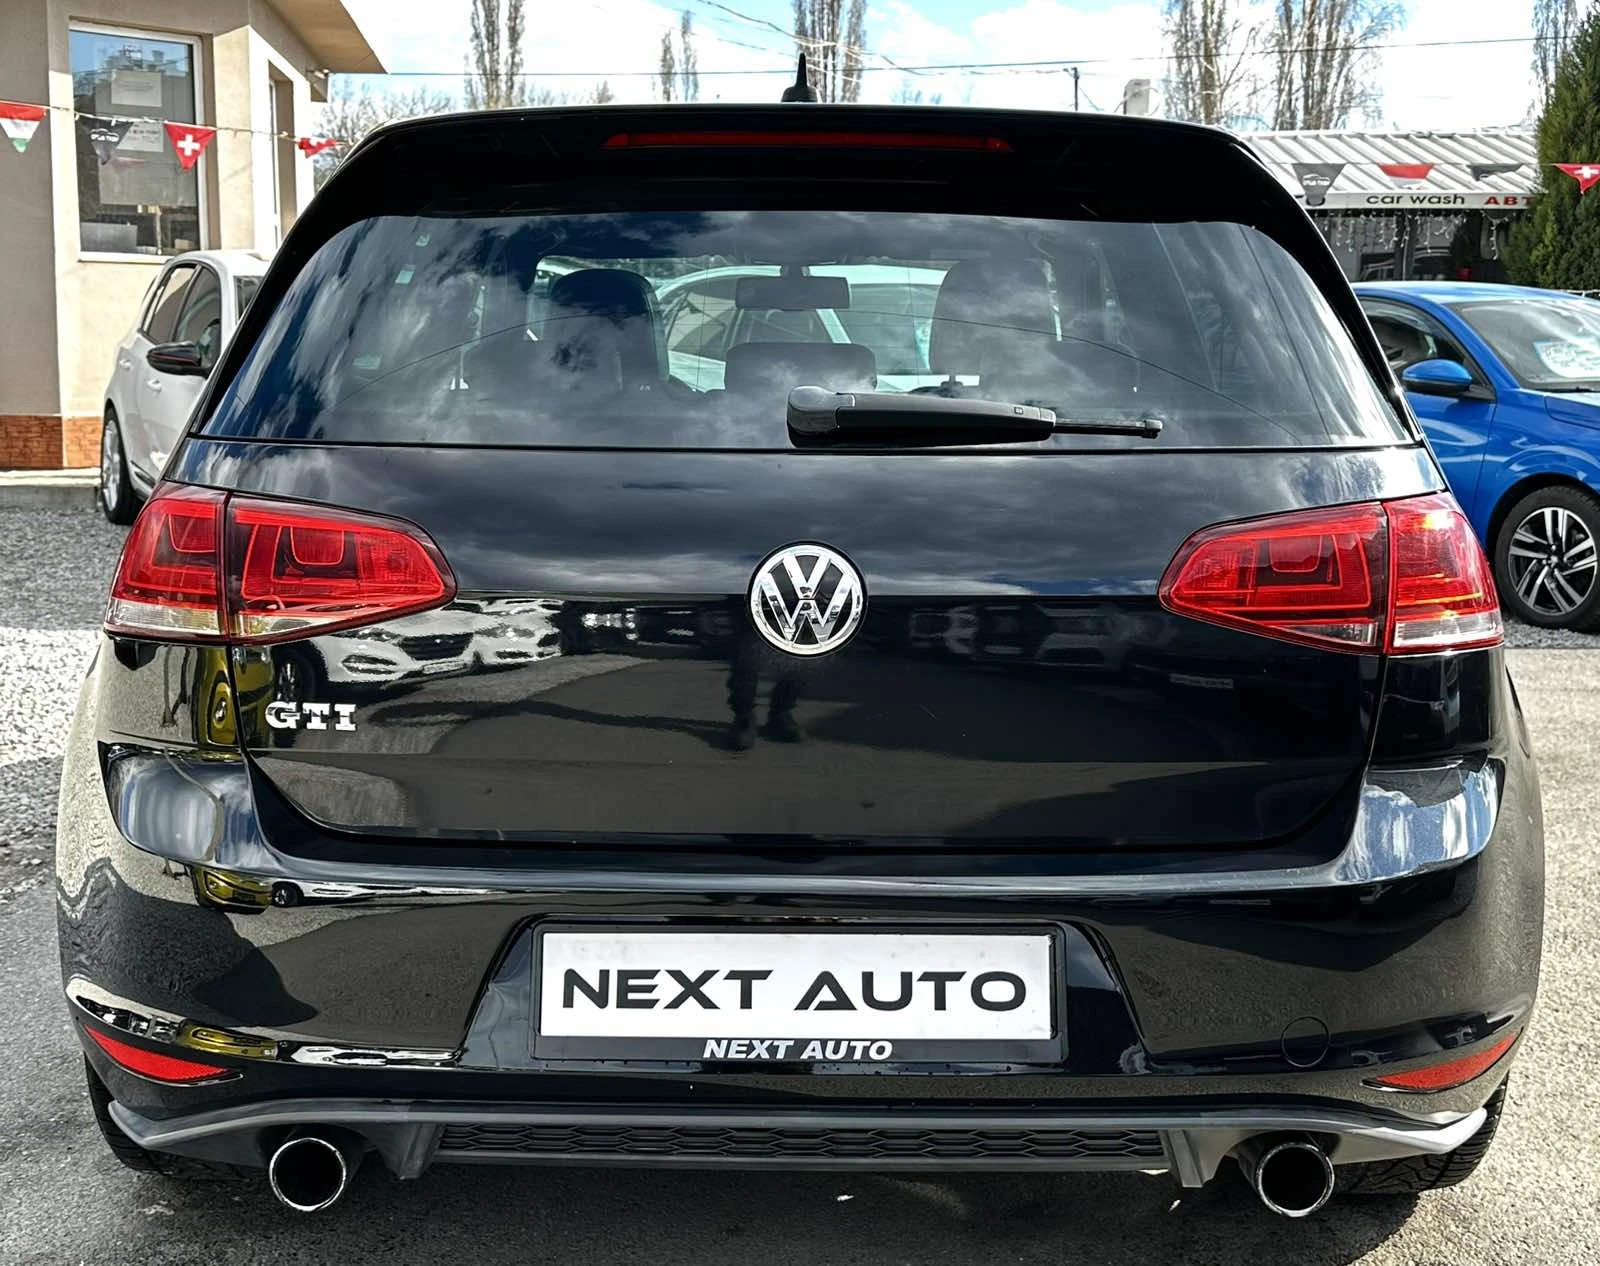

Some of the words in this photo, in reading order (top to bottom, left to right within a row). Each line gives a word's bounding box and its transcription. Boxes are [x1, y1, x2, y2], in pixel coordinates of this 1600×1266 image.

[1366, 195, 1403, 205] car
[1409, 194, 1465, 205] wash
[265, 701, 357, 731] GTI
[562, 968, 773, 1010] NEXT
[794, 970, 1026, 1012] AUTO
[703, 1039, 795, 1059] NEXT
[800, 1040, 893, 1060] AUTO
